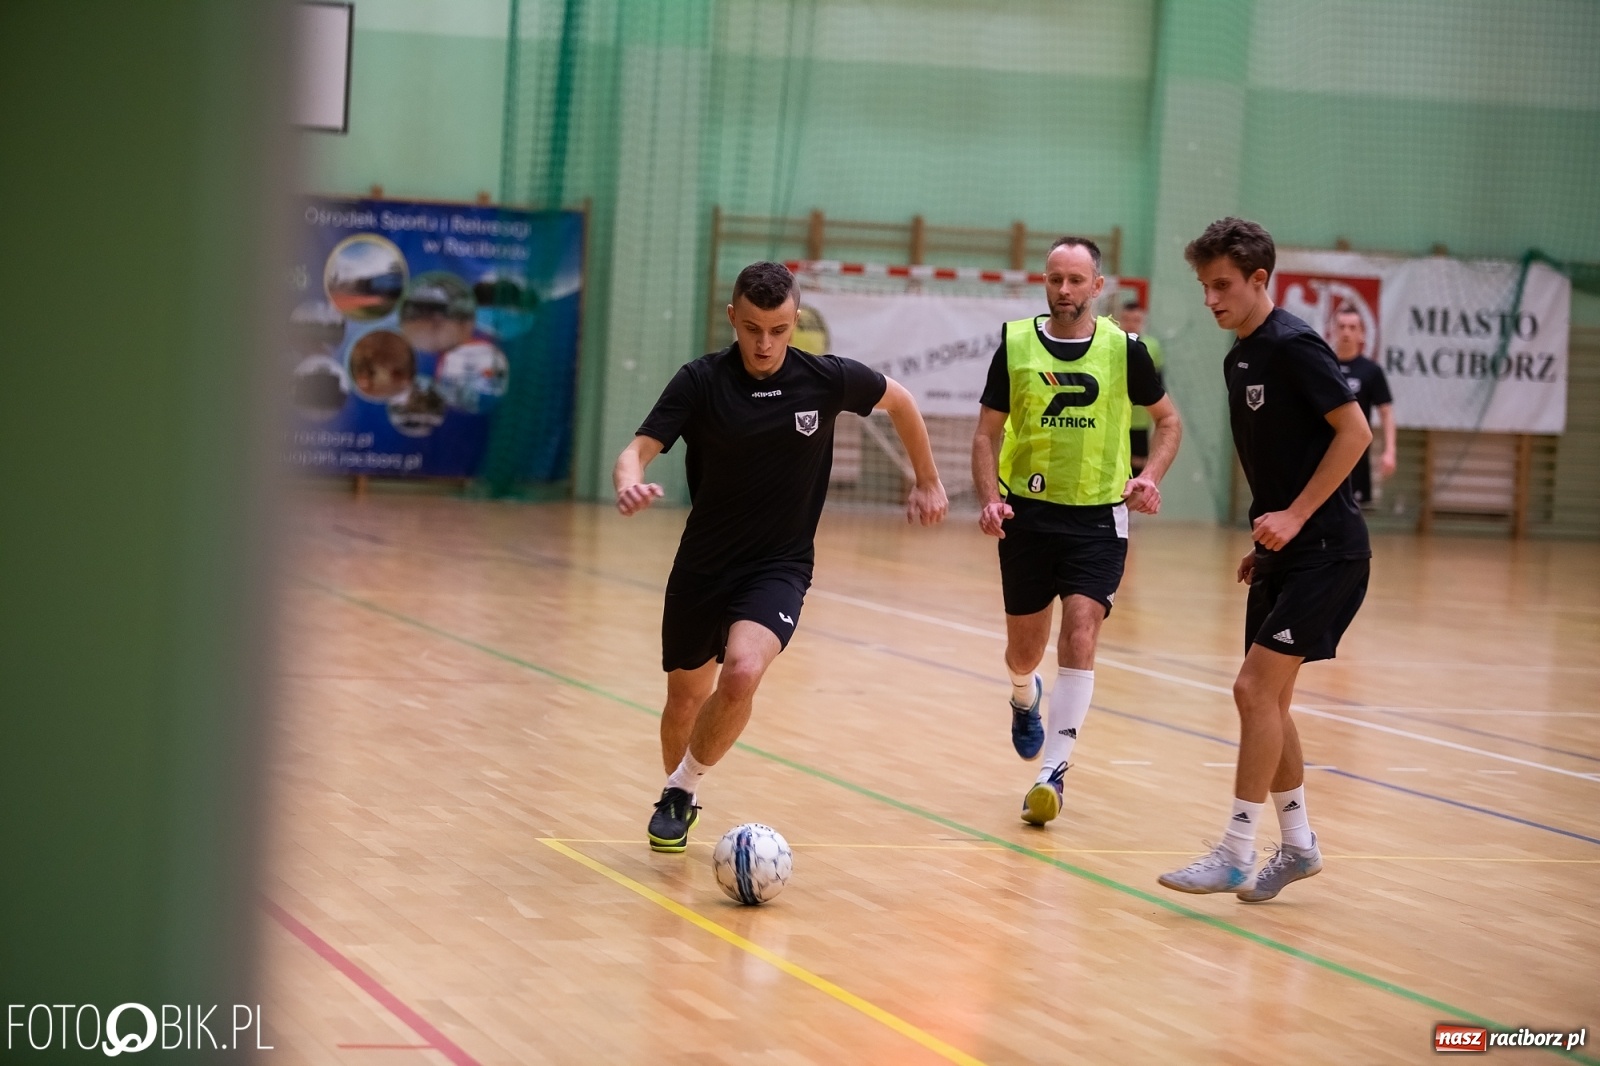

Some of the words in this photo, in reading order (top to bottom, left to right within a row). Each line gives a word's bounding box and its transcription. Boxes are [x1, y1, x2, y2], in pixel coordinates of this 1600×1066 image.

[1408, 306, 1539, 341] MIASTO
[1040, 417, 1096, 428] PATRICK
[1031, 474, 1043, 493] 9
